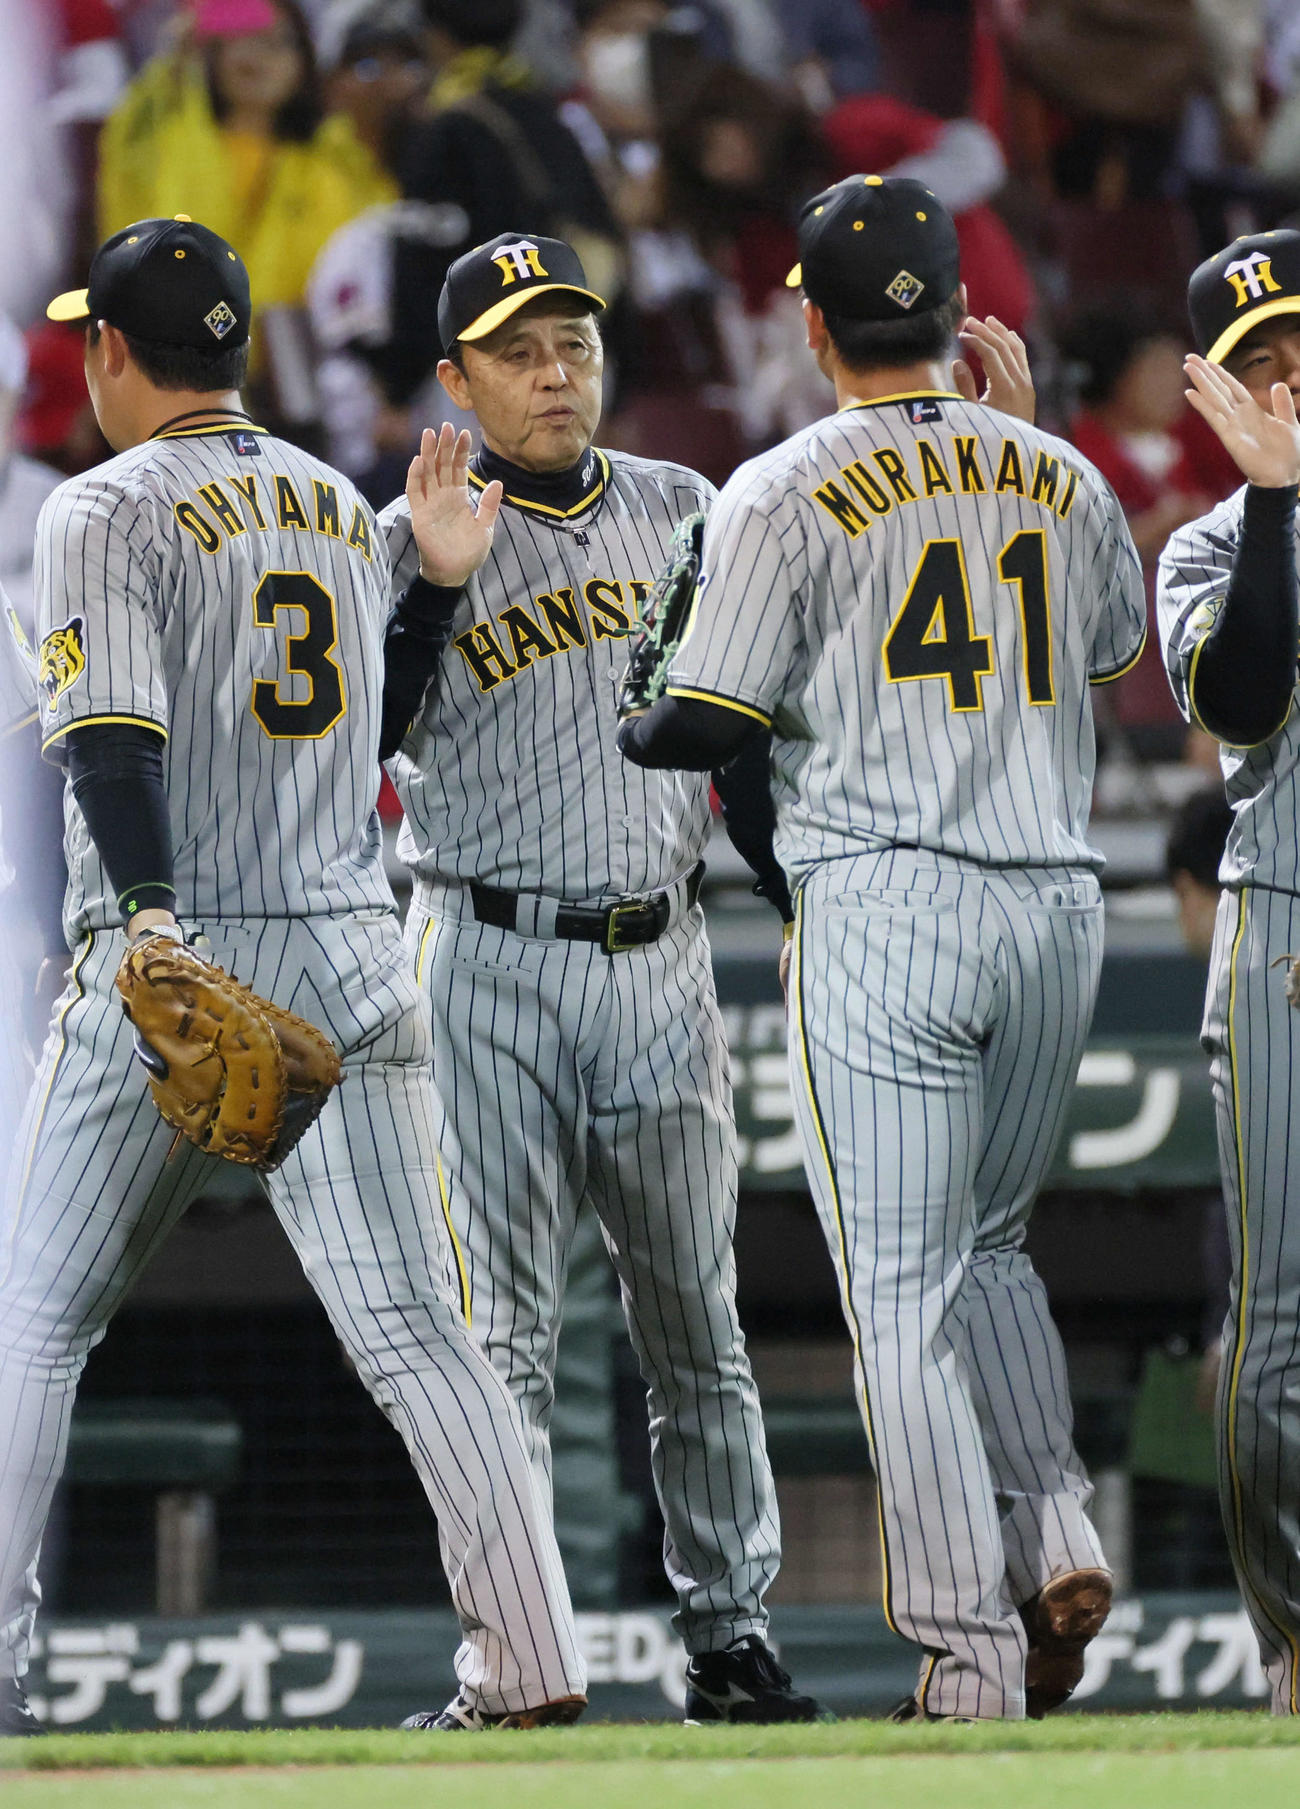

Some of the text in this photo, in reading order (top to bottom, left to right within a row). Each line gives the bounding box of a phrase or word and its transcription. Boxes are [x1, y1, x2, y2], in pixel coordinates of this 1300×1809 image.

[173, 474, 373, 563] OHYAMA
[812, 435, 1082, 540] MURAKAMI
[251, 570, 347, 740] 3
[881, 528, 1057, 713] 41
